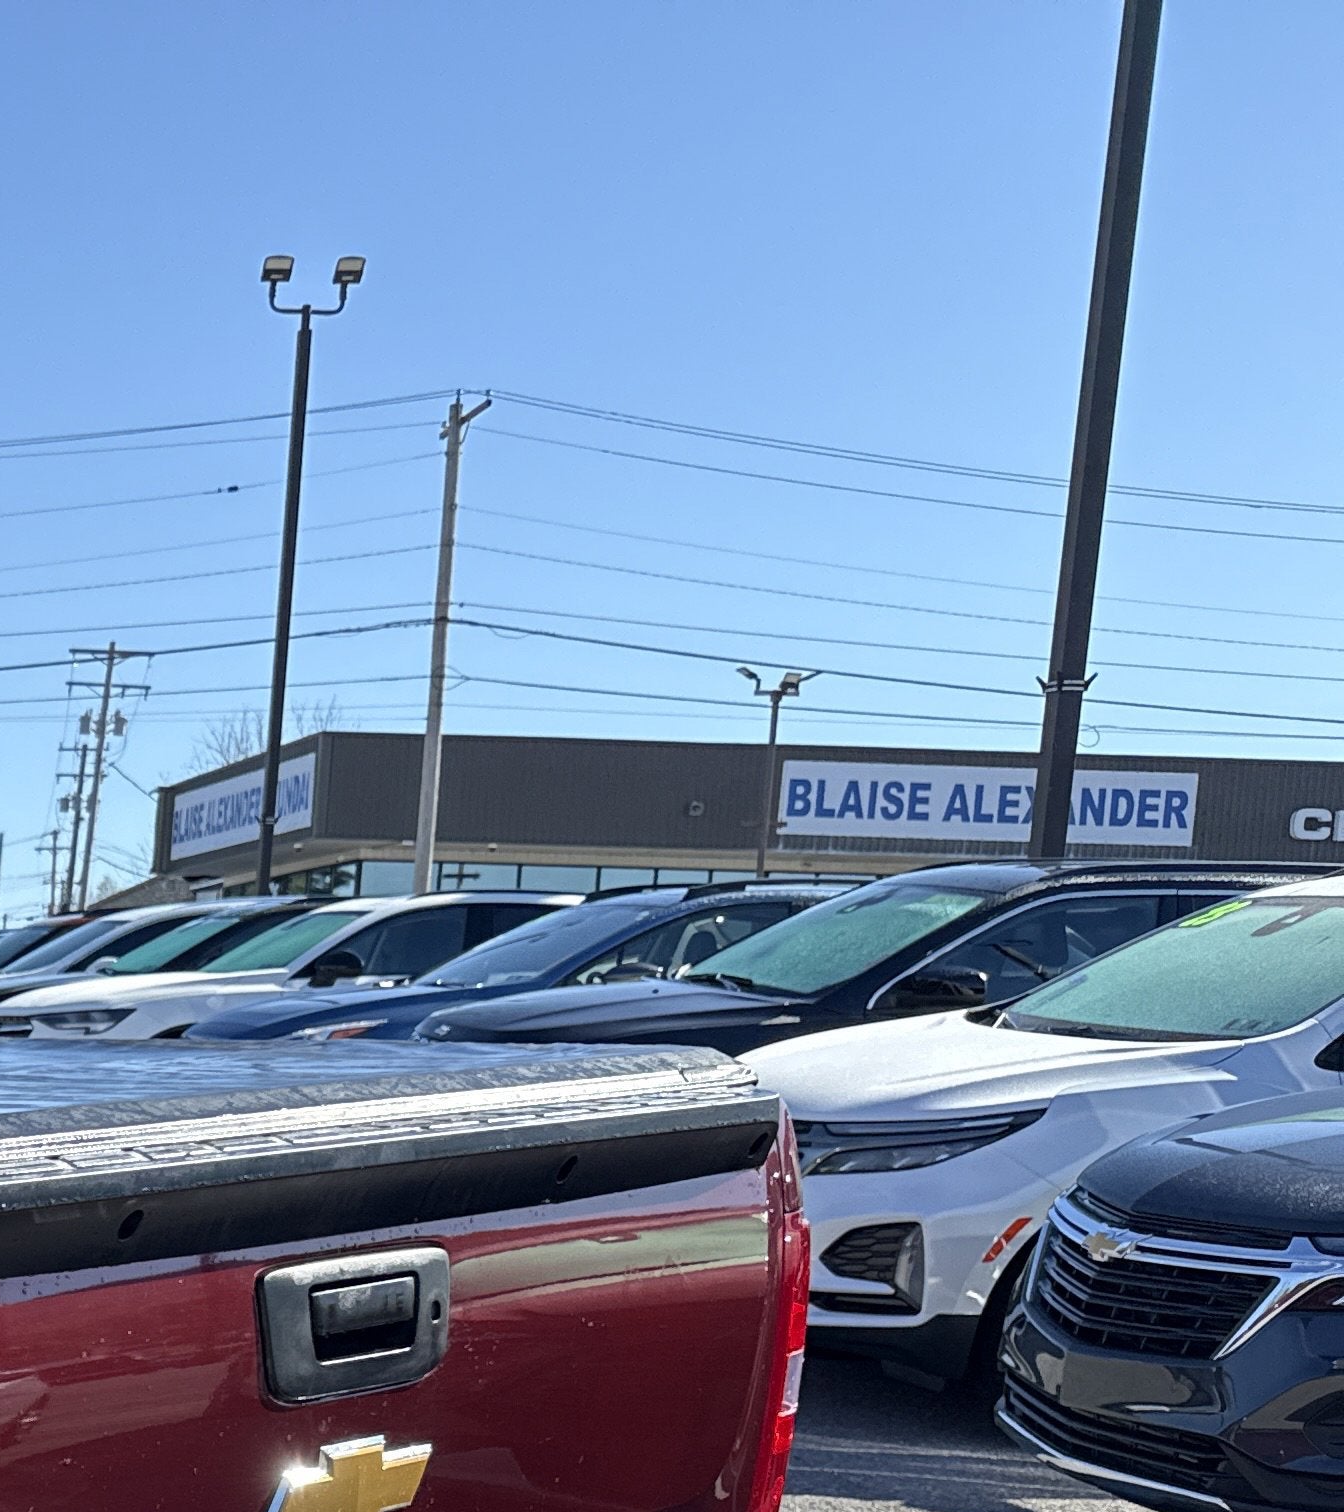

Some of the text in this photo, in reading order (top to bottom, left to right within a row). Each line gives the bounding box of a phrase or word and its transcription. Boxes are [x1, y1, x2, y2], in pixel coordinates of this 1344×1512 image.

[173, 771, 310, 844] BLAISE ALEXANDER UNDAI
[786, 778, 1190, 830] BLAISE ALENDER
